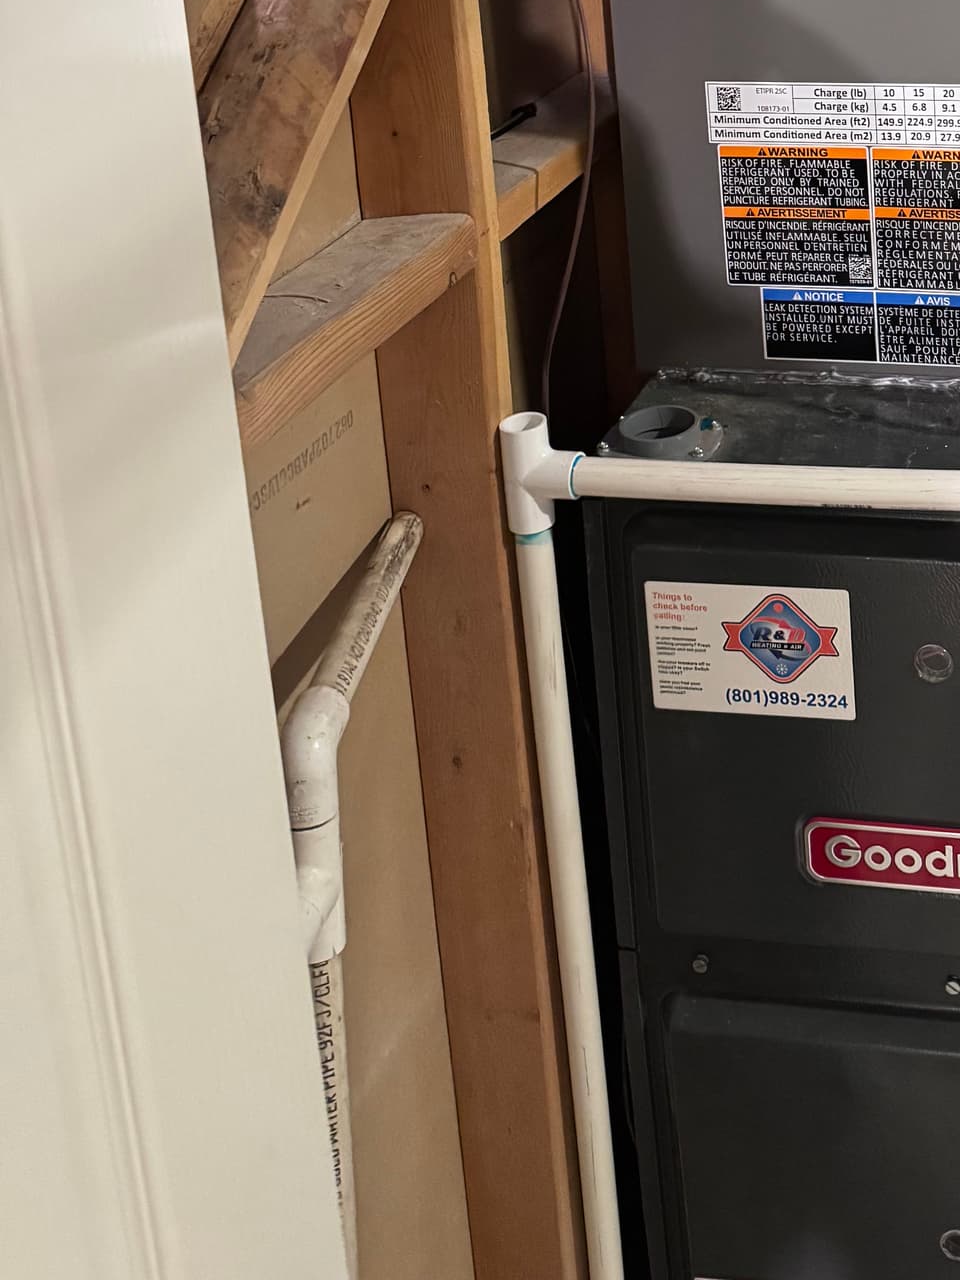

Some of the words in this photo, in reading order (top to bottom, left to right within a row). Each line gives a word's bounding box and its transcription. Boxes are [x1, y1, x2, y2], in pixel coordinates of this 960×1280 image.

[814, 88, 848, 99] Charge
[850, 88, 867, 100] (lb)
[883, 89, 895, 98] 10
[913, 89, 925, 98] 15
[943, 90, 955, 98] 20
[814, 101, 848, 113] Charge
[850, 101, 869, 113] (kg)
[882, 102, 897, 112] 4.5
[912, 102, 927, 112] 6.8
[941, 102, 956, 112] 9.1
[714, 115, 760, 125] Minimum
[762, 116, 823, 126] Conditioned
[825, 117, 848, 127] Area
[850, 116, 871, 127] (ft2)
[877, 118, 903, 127] 149.9
[907, 117, 933, 127] 224.9
[715, 129, 761, 140] Minimum
[762, 130, 823, 140] Conditioned
[825, 131, 848, 141] Area
[850, 131, 873, 142] (m2)
[880, 132, 901, 141] 13.9
[911, 132, 931, 141] 20.9
[940, 133, 960, 142] 27.9
[768, 148, 828, 157] WARNING
[758, 208, 847, 218] AVERTISSEMENT
[804, 291, 844, 302] NOTICE
[927, 297, 951, 306] AVIS
[765, 304, 786, 312] LEAK
[788, 305, 837, 314] DETECTION
[839, 306, 874, 315] SYSTEM
[819, 315, 843, 323] UNIT
[847, 316, 873, 325] MUST
[766, 323, 778, 332] BE
[783, 324, 832, 333] POWERED
[836, 326, 873, 334] EXCEPT
[766, 332, 786, 341] FOR
[789, 334, 837, 343] SERVICE.
[652, 592, 681, 602] Things
[681, 604, 707, 612] before
[774, 630, 785, 641] &
[726, 688, 848, 708] (801)989-2324
